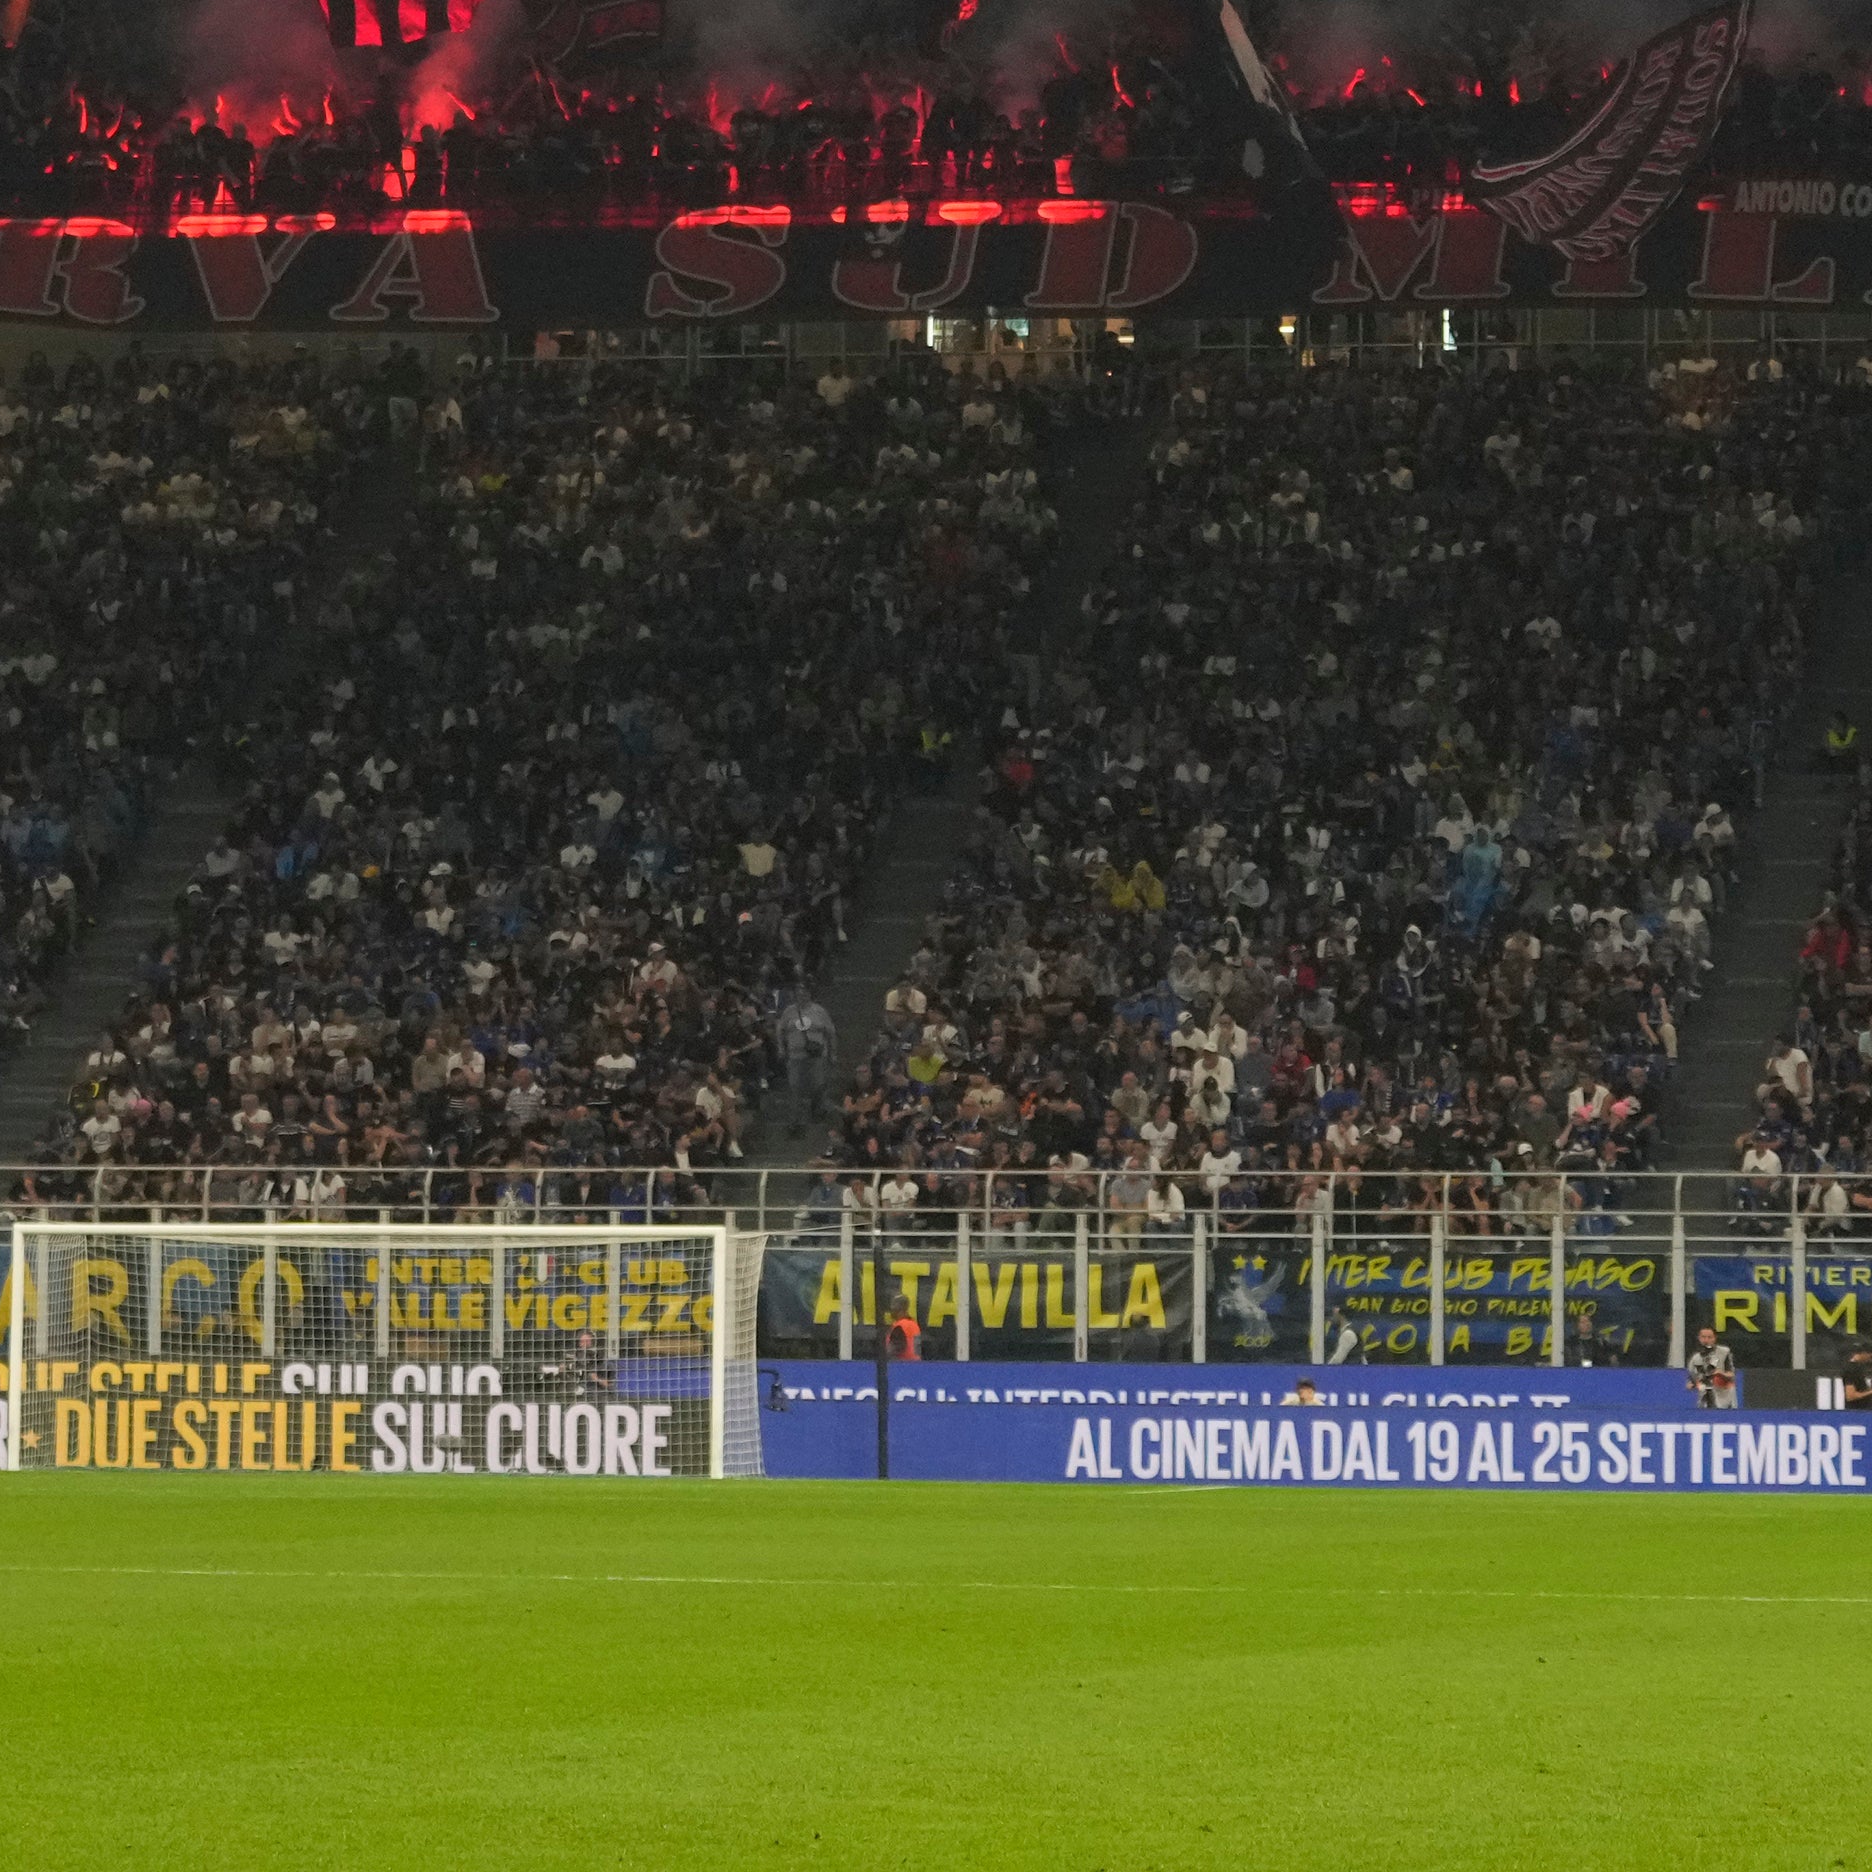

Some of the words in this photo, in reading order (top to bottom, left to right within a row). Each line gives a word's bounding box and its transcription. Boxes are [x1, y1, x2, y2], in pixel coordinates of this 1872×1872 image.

[1734, 180, 1836, 217] ANTONIO
[644, 199, 1199, 319] SUD
[1399, 1256, 1496, 1292] CUB
[1507, 1257, 1656, 1293] PEASO
[1346, 1296, 1383, 1317] SAN
[1390, 1297, 1479, 1317] GIOGIO
[1486, 1297, 1598, 1319] PIACENNO
[54, 1398, 162, 1469] DUE
[171, 1399, 362, 1473] STELLE
[486, 1402, 673, 1476] CUORE
[1064, 1417, 1123, 1479] AL
[1129, 1417, 1304, 1481] CINEMA
[1311, 1419, 1400, 1482] DAL
[1404, 1420, 1459, 1483] 19
[1466, 1421, 1526, 1483] AL
[1532, 1421, 1590, 1484] 25
[1596, 1421, 1867, 1487] SETTEMBRE
